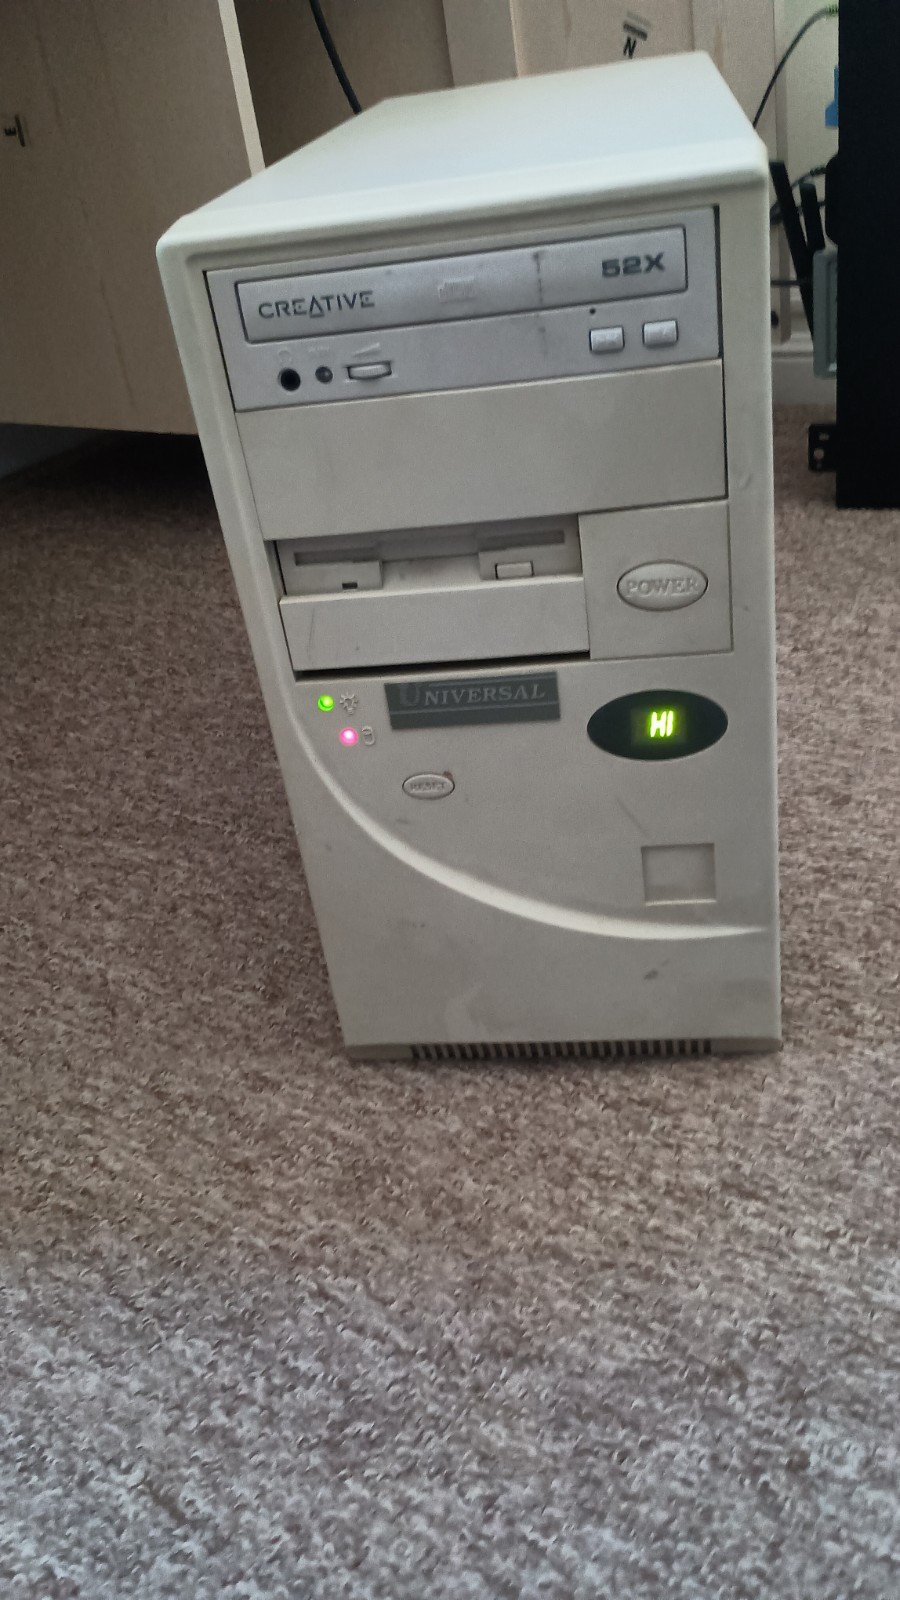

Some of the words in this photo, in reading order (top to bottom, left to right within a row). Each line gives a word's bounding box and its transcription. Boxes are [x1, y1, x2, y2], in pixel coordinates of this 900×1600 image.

[601, 252, 665, 277] 52X
[258, 290, 375, 319] CREATIVE
[625, 577, 700, 598] POWER
[400, 683, 545, 707] UNIVERSAL
[650, 710, 674, 738] HI
